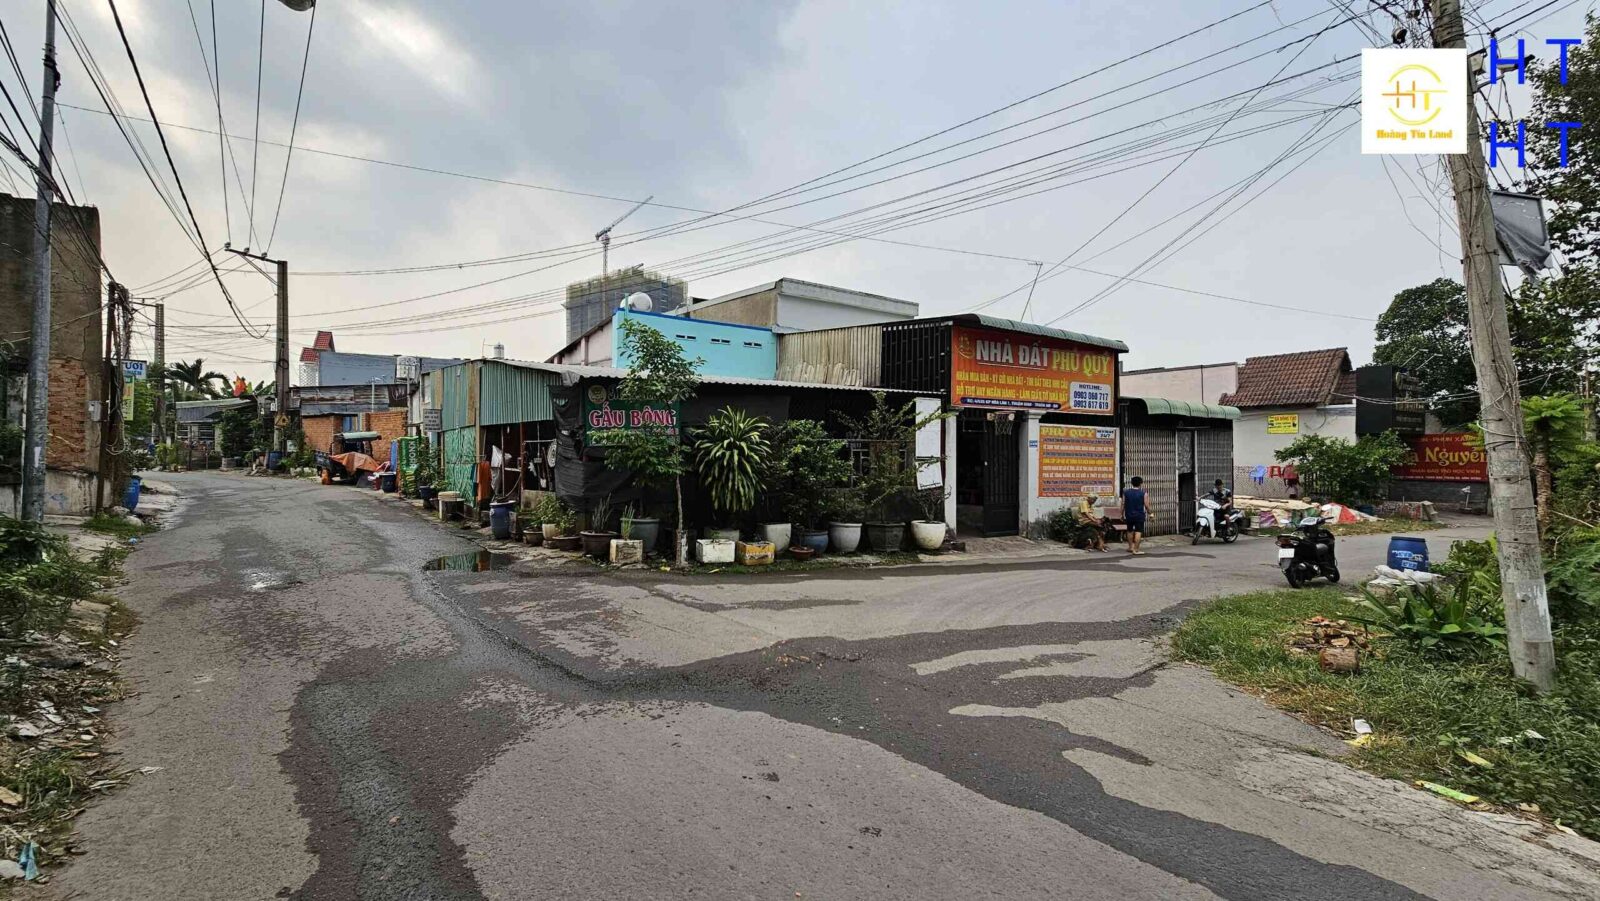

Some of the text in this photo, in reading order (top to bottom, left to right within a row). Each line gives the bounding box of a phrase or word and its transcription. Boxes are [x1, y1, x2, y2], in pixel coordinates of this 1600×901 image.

[976, 338, 1014, 364] NHÀ
[1018, 340, 1050, 367] ĐẤT
[589, 401, 676, 427] GẤU BÔNG
